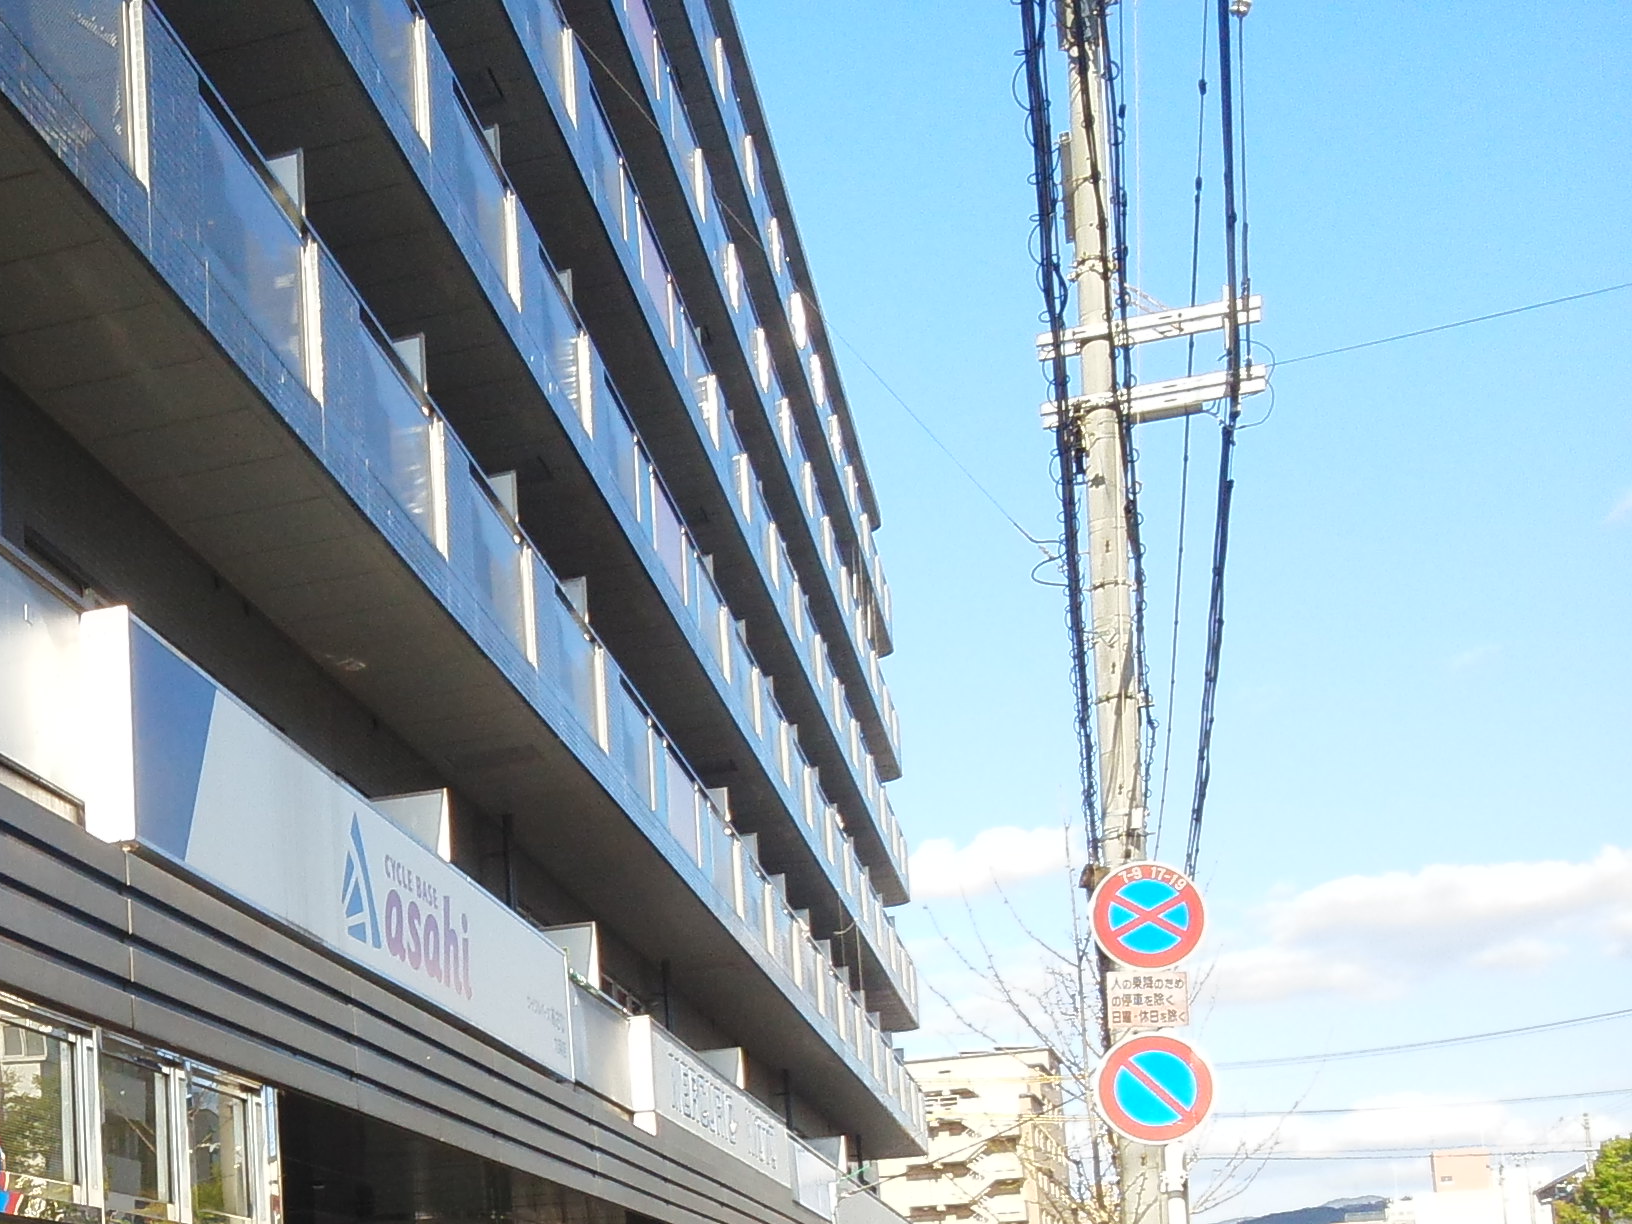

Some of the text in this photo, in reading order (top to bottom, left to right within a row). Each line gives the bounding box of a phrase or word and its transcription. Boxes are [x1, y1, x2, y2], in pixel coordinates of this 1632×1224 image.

[384, 854, 439, 910] CYCLE BASE
[1118, 866, 1187, 891] 7-9 17-19
[385, 888, 473, 1001] asahi
